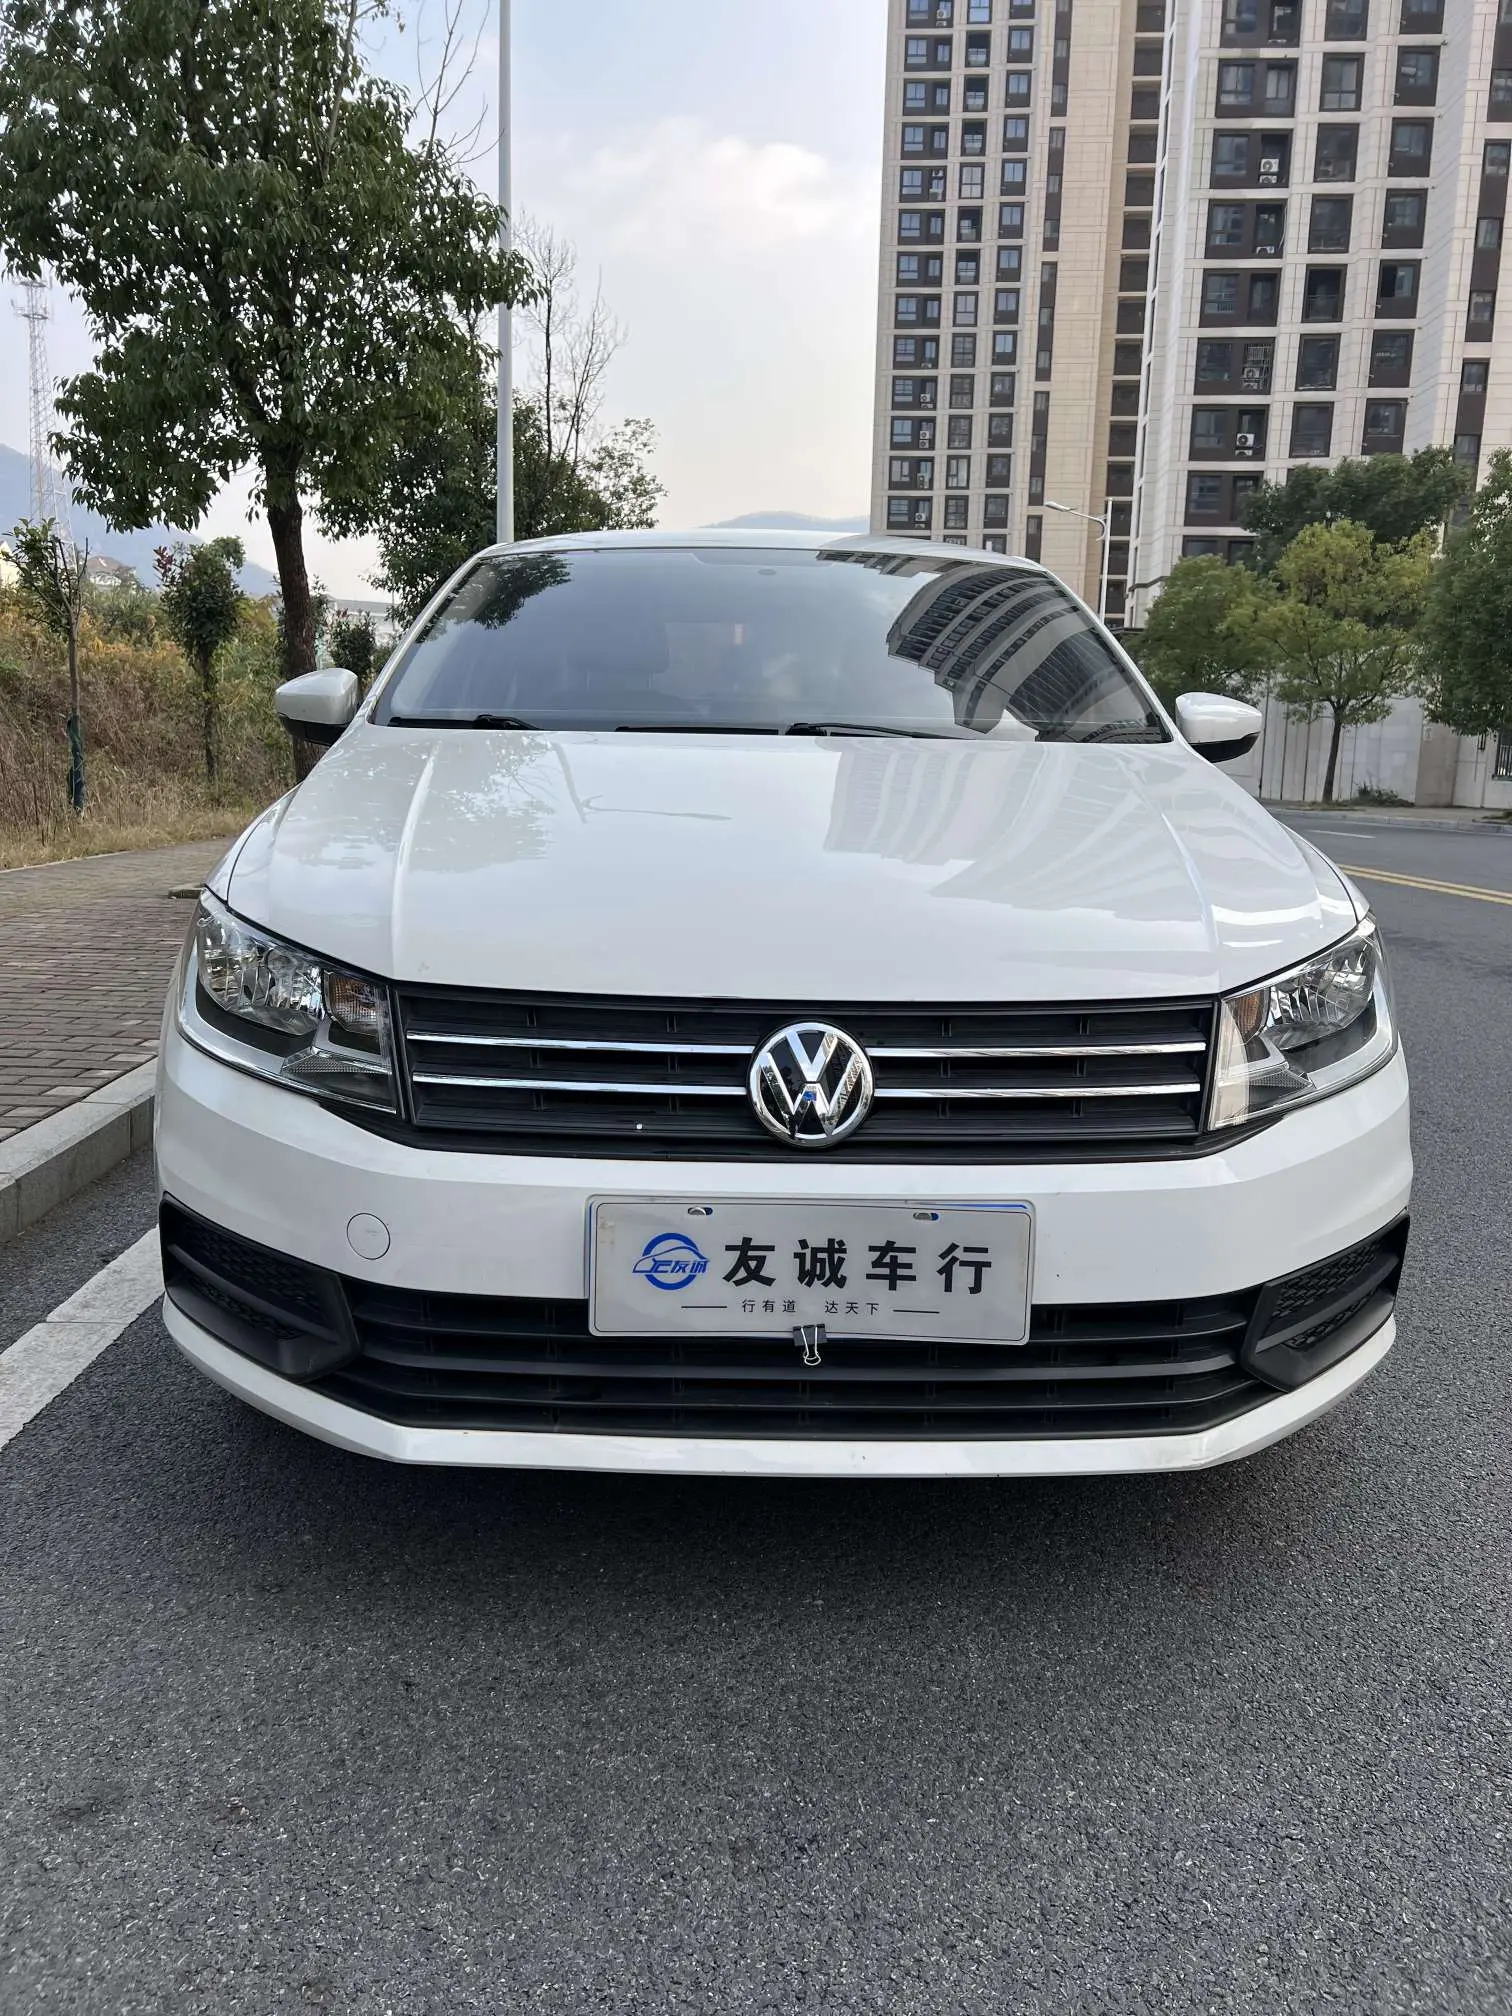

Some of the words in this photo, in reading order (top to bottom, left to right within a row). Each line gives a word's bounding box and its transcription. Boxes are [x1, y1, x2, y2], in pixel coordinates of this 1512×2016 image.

[722, 1237, 993, 1295] 友诚车行
[741, 1299, 797, 1313] 行有道
[824, 1300, 880, 1315] 达天下
